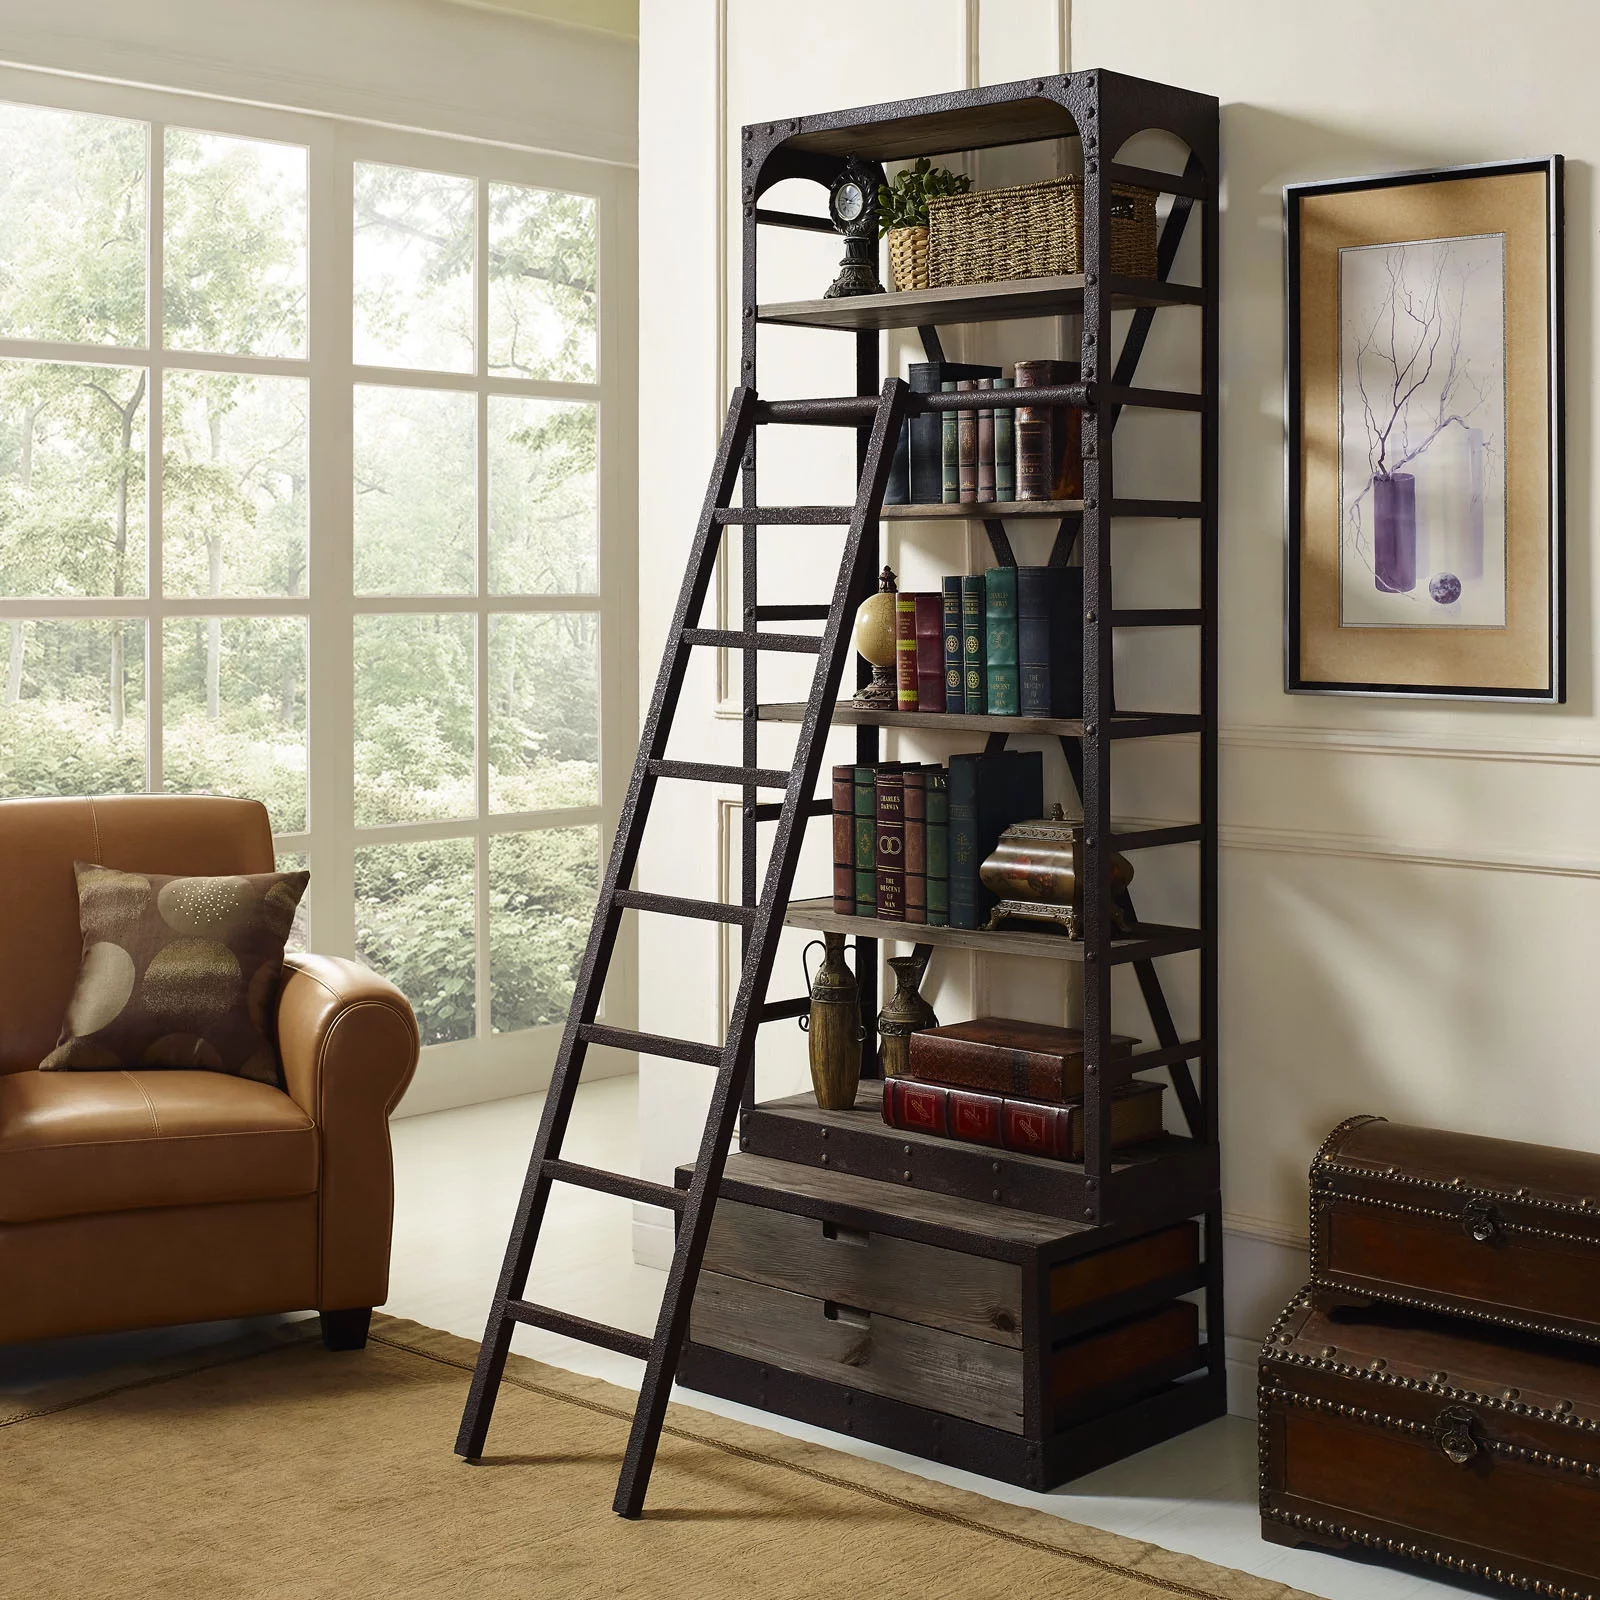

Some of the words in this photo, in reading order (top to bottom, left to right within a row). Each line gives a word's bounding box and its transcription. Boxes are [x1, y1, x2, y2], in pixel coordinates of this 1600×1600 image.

[879, 795, 900, 803] CHARLES
[880, 803, 899, 811] DARWIN
[885, 877, 895, 885] THE
[879, 885, 901, 893] DESCENT
